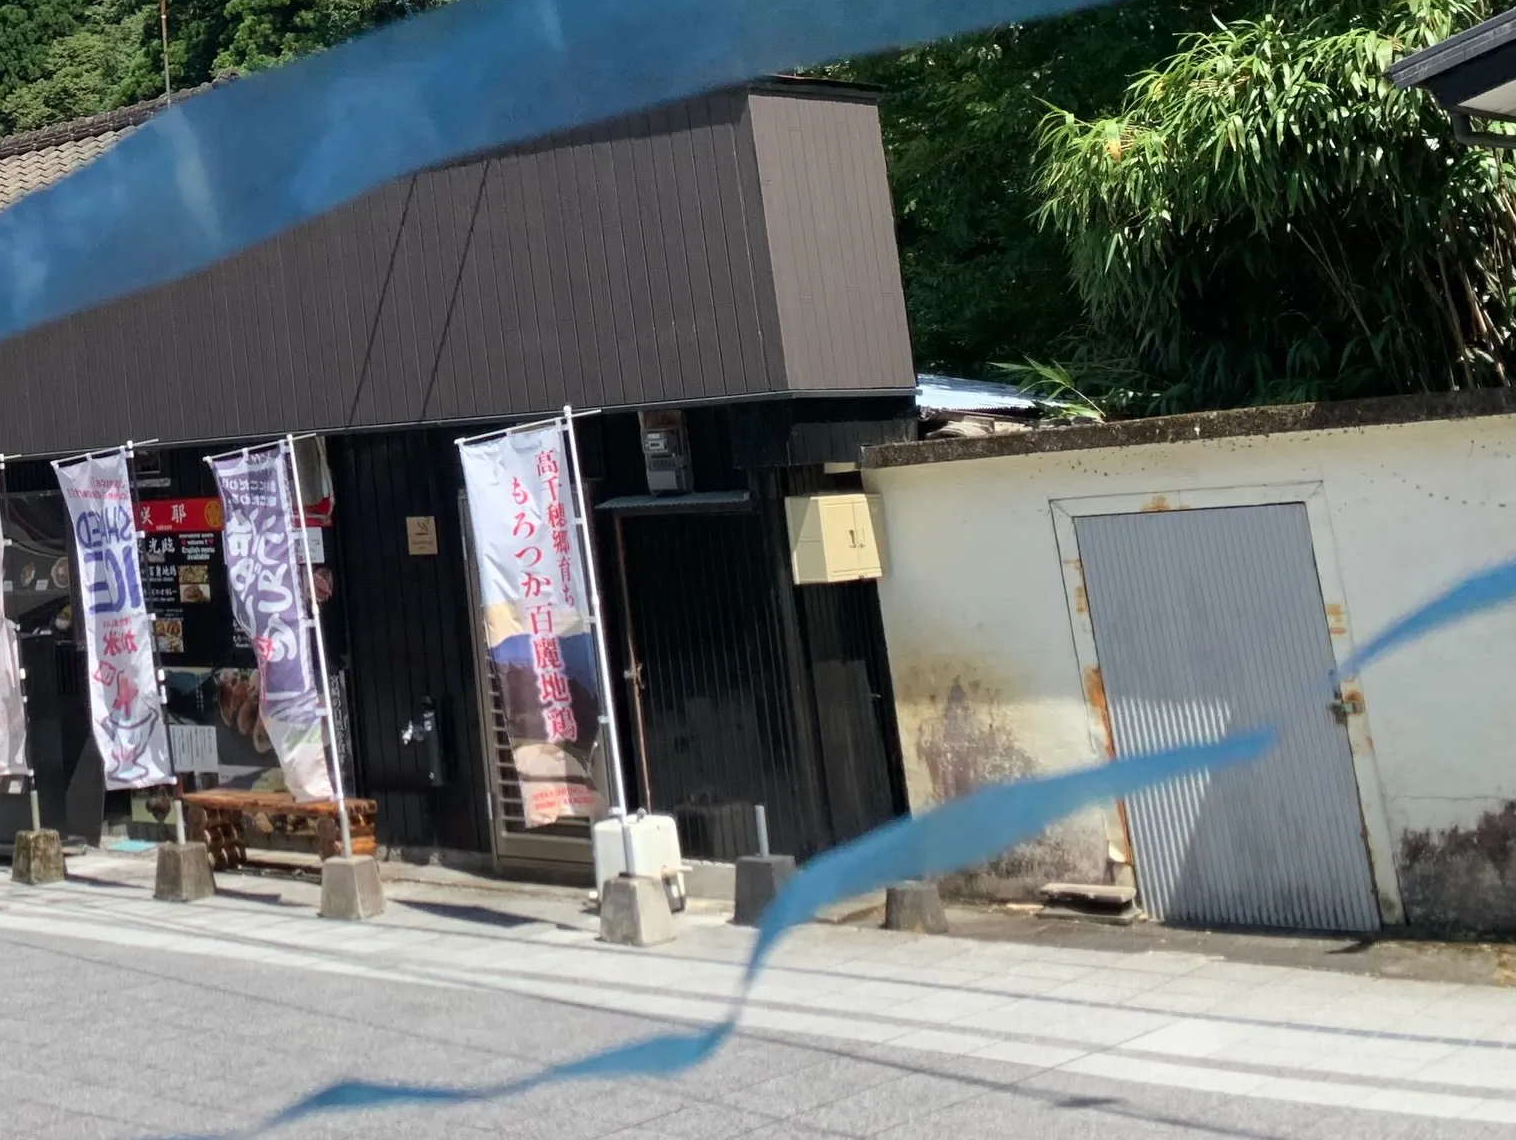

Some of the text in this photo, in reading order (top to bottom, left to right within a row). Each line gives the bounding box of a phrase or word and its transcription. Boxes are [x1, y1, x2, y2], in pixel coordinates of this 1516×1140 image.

[181, 546, 201, 554] English
[535, 449, 574, 607] 高千穂郷育ち
[511, 476, 577, 742] もろつか百麗地鶏
